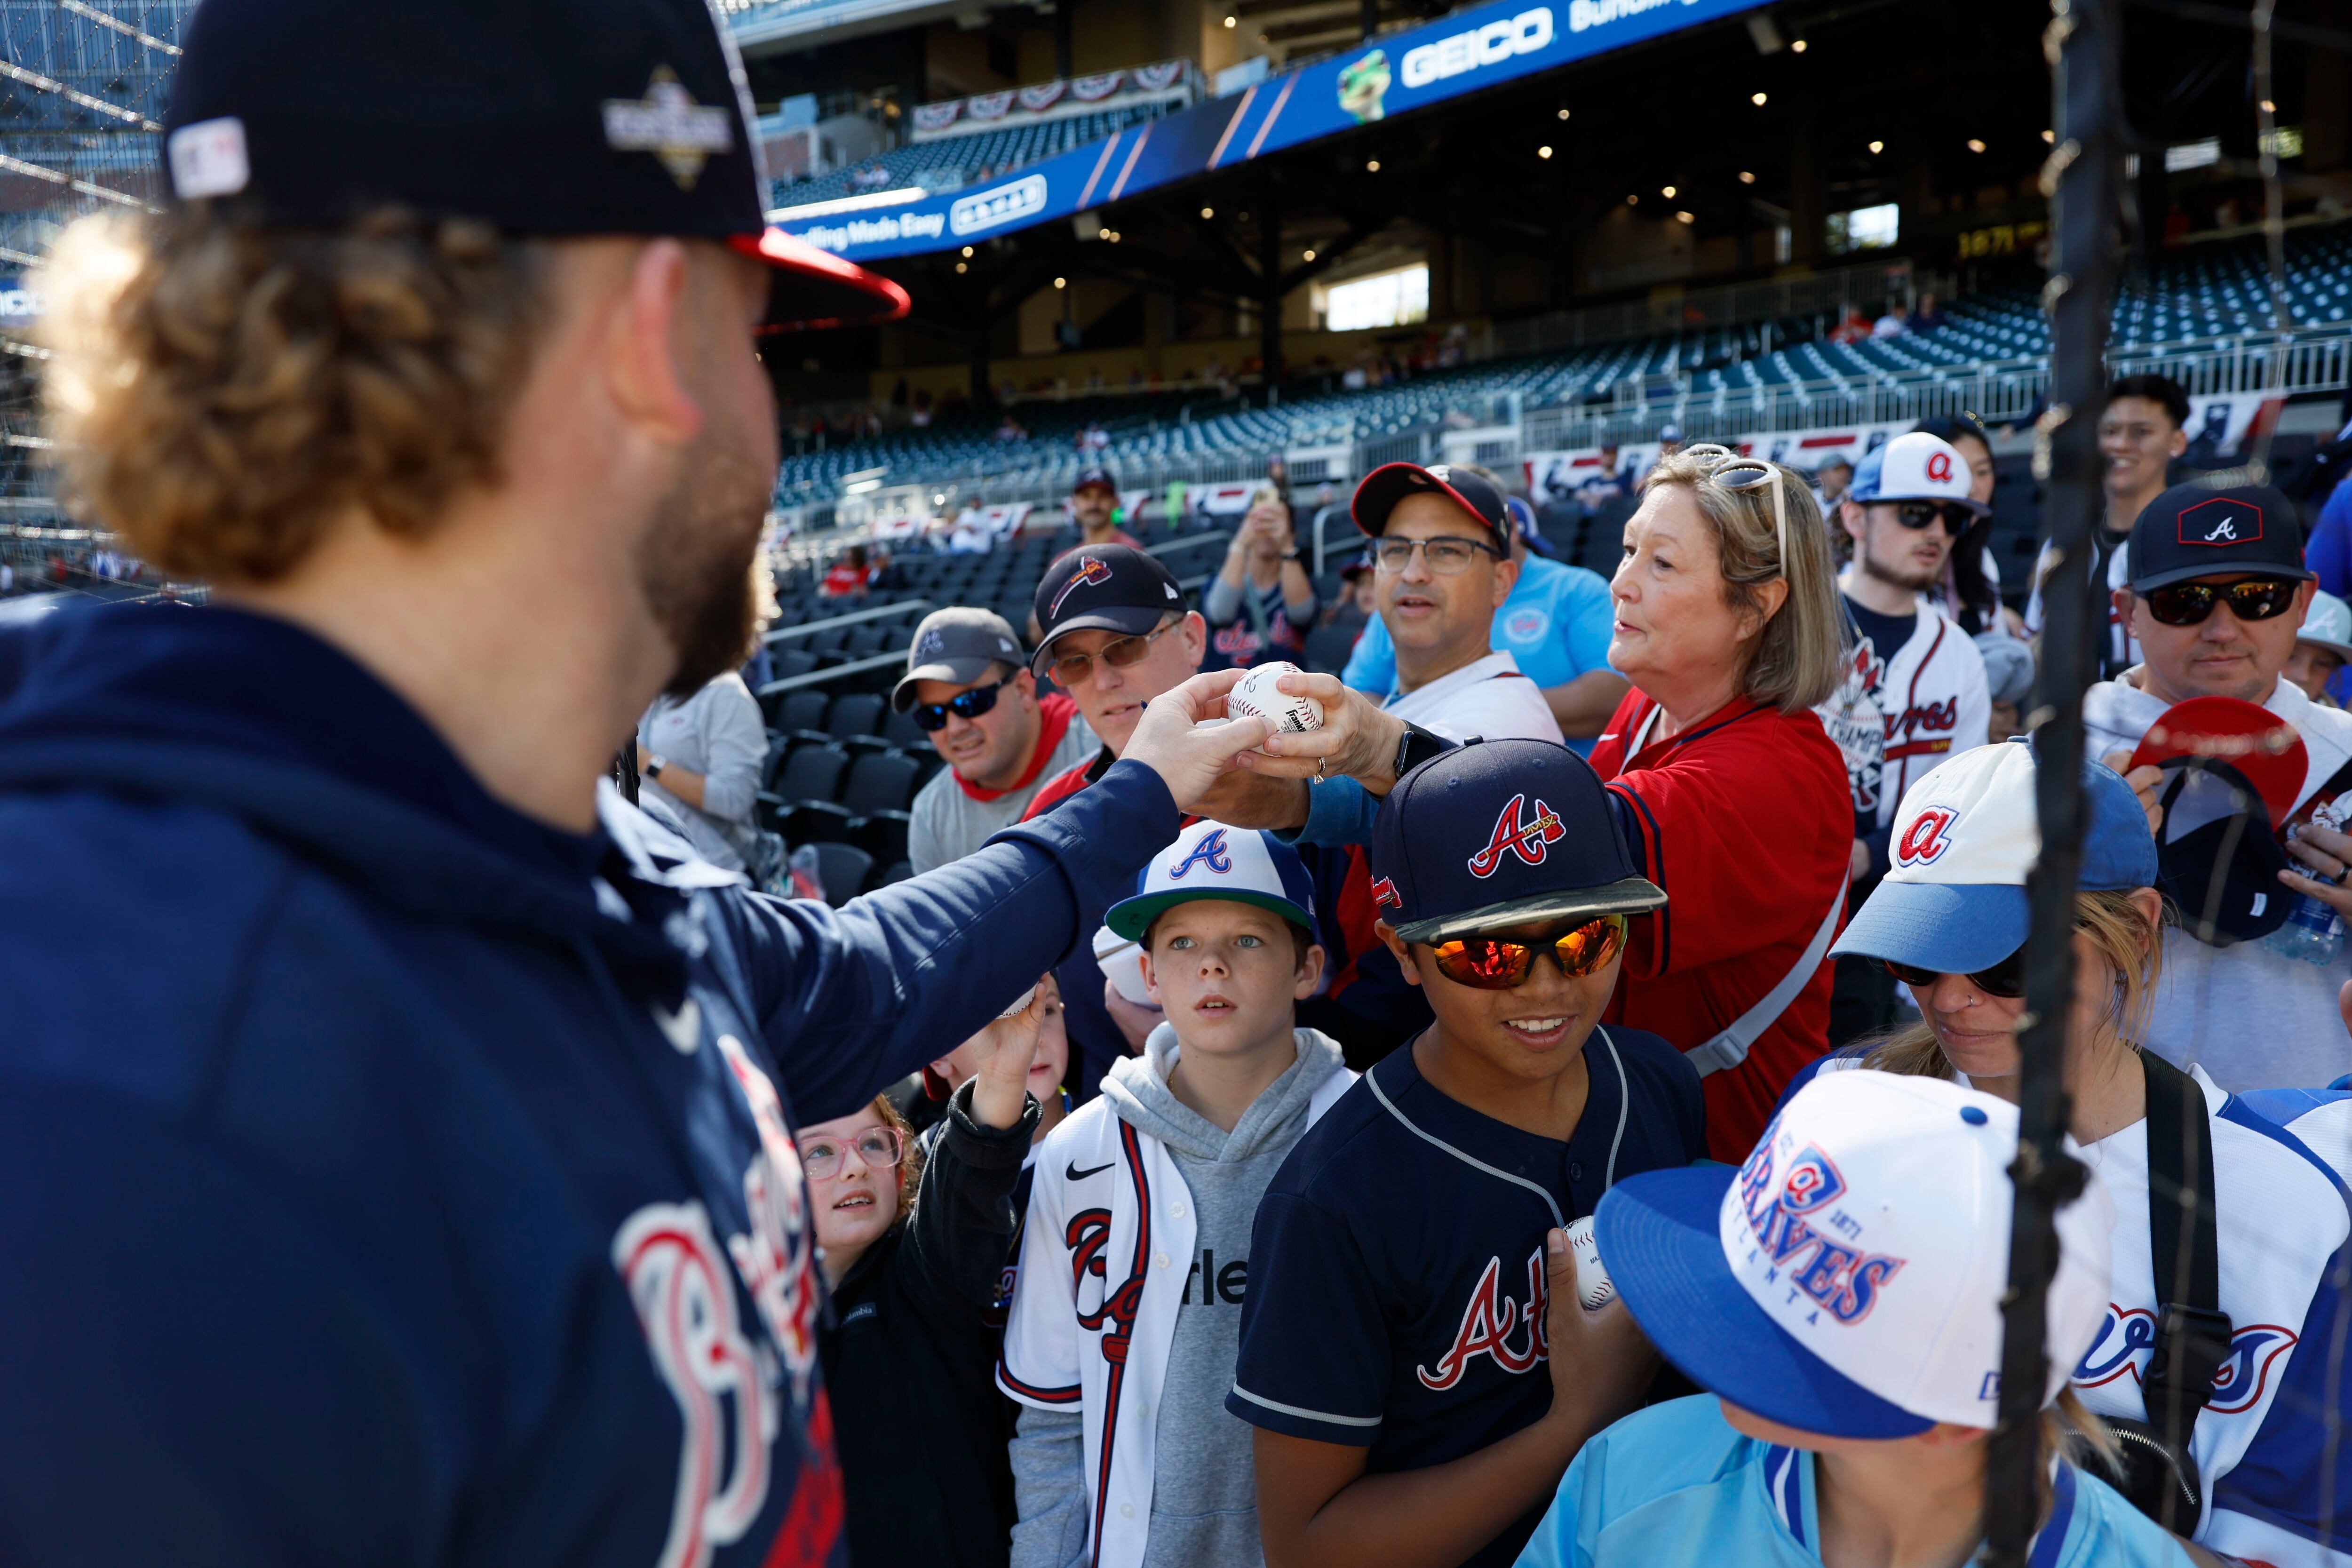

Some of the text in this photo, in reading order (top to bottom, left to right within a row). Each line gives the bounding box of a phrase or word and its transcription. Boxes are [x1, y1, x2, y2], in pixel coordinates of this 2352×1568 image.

[1401, 7, 1552, 88] GEICO
[899, 212, 945, 239] Easy
[2204, 516, 2237, 541] A
[1169, 828, 1232, 880] A
